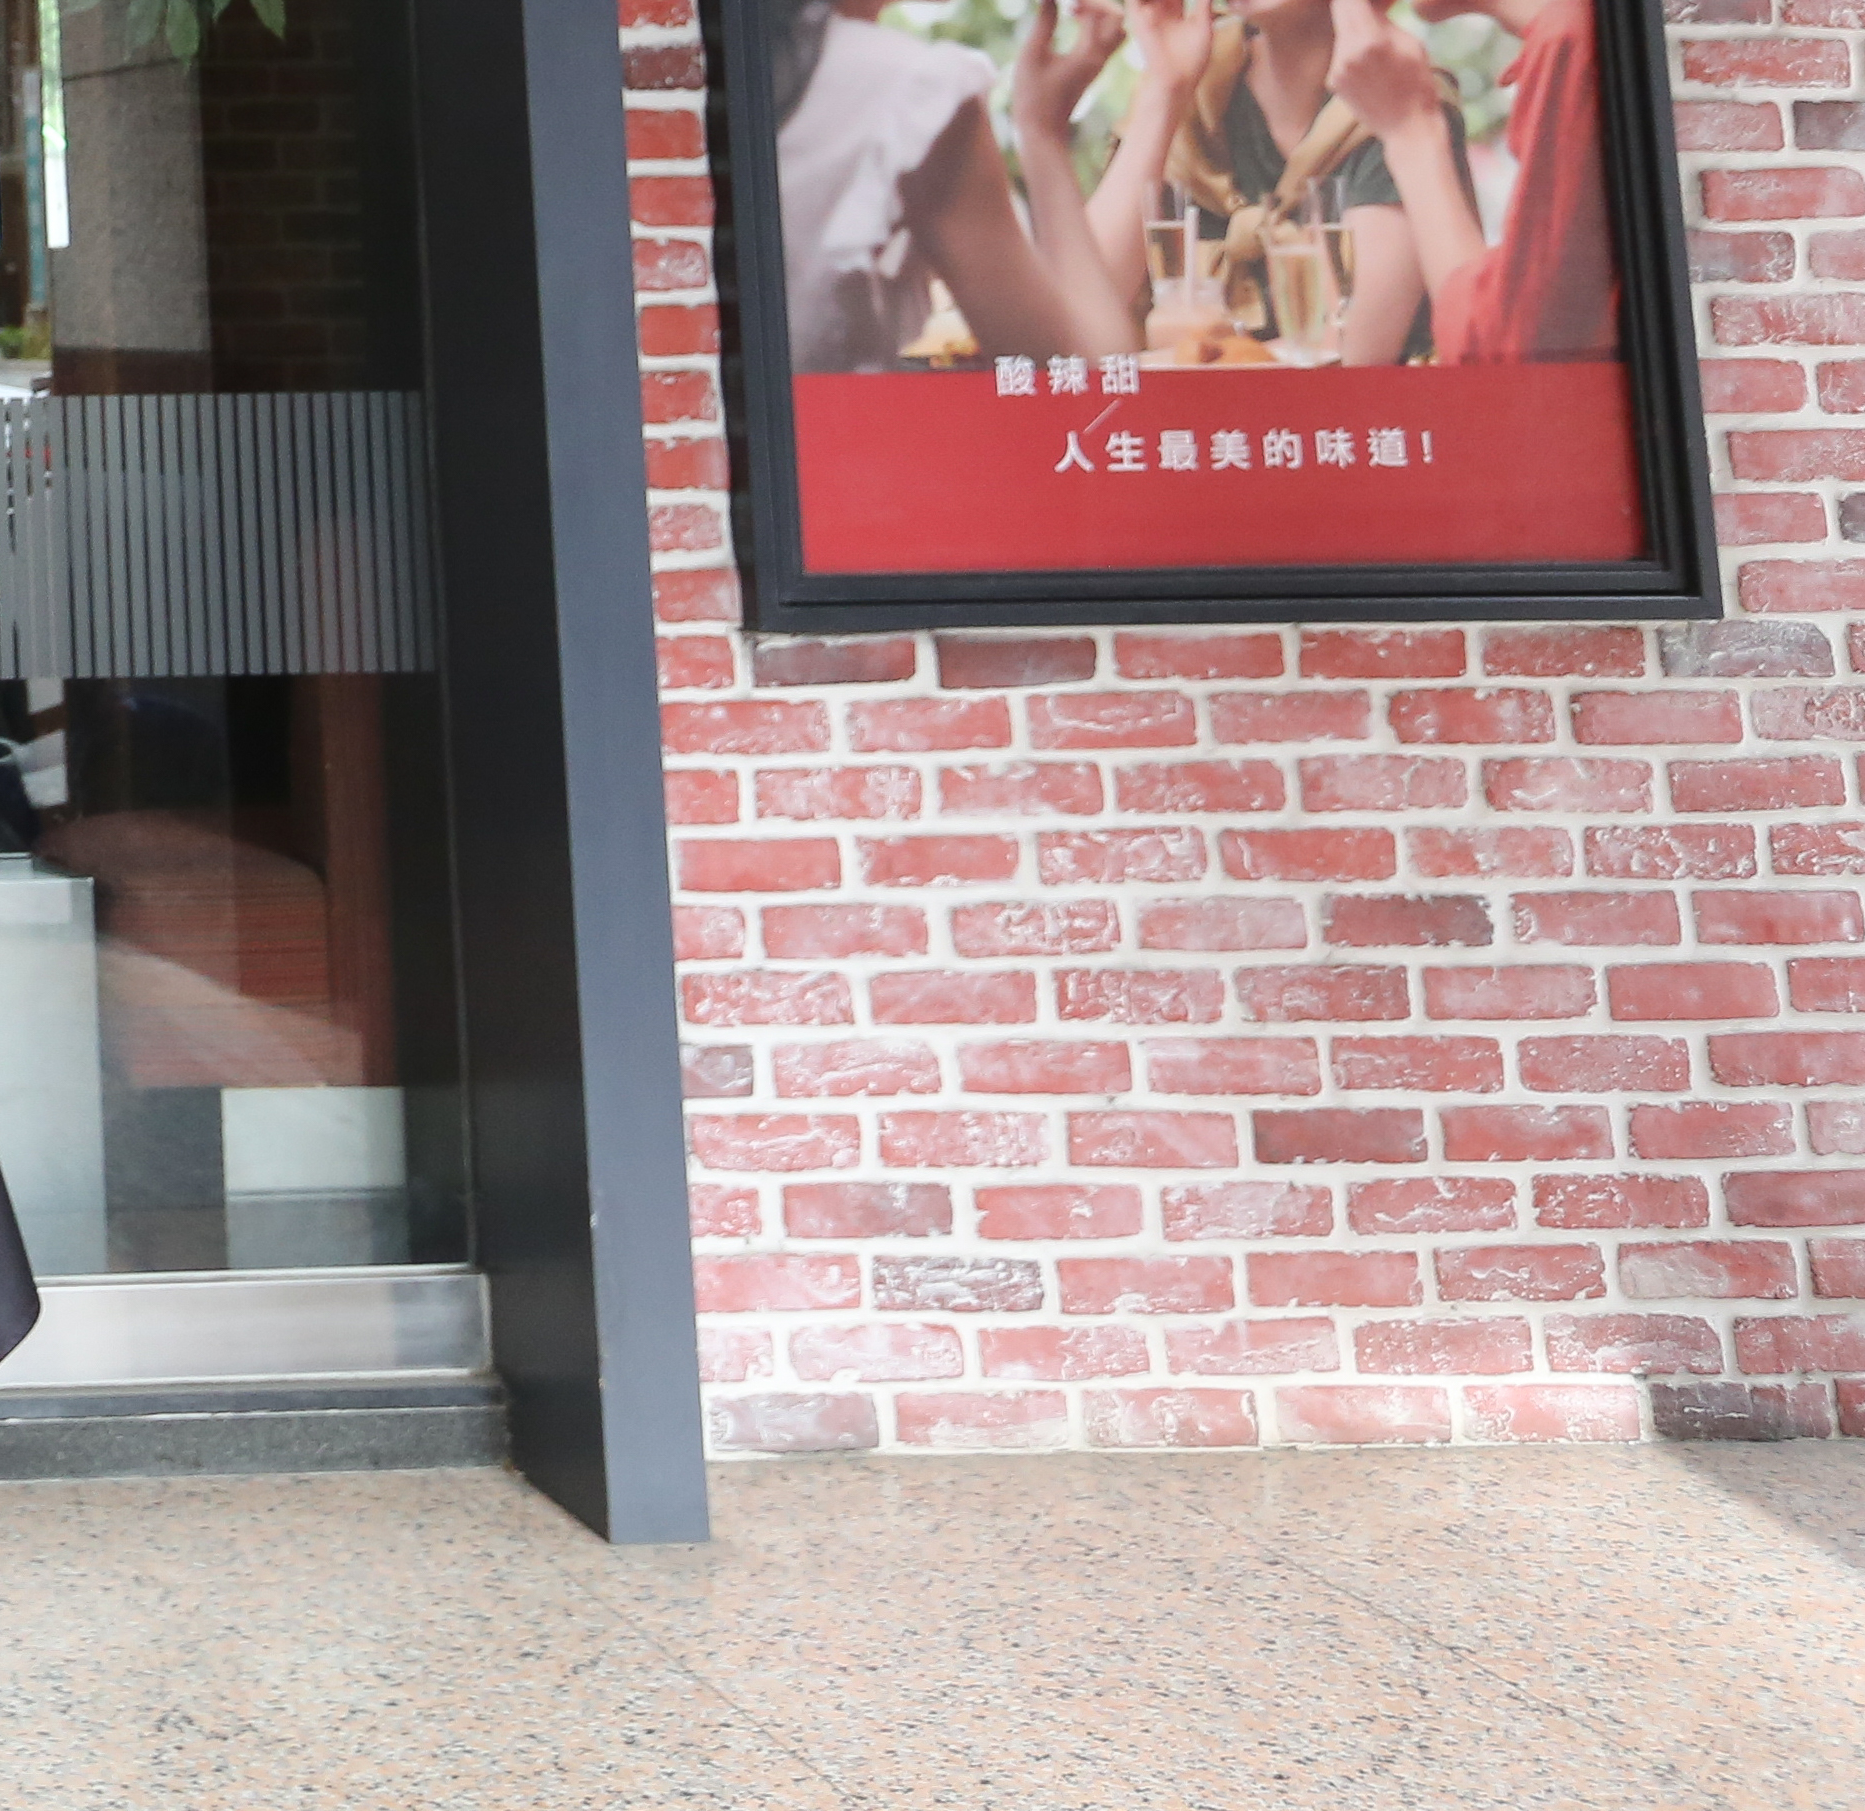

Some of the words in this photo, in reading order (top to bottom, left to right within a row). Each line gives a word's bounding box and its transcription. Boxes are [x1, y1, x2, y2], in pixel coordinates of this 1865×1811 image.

[993, 353, 1141, 398] 酸辣甜
[1054, 427, 1434, 474] 人生最美的味道！
